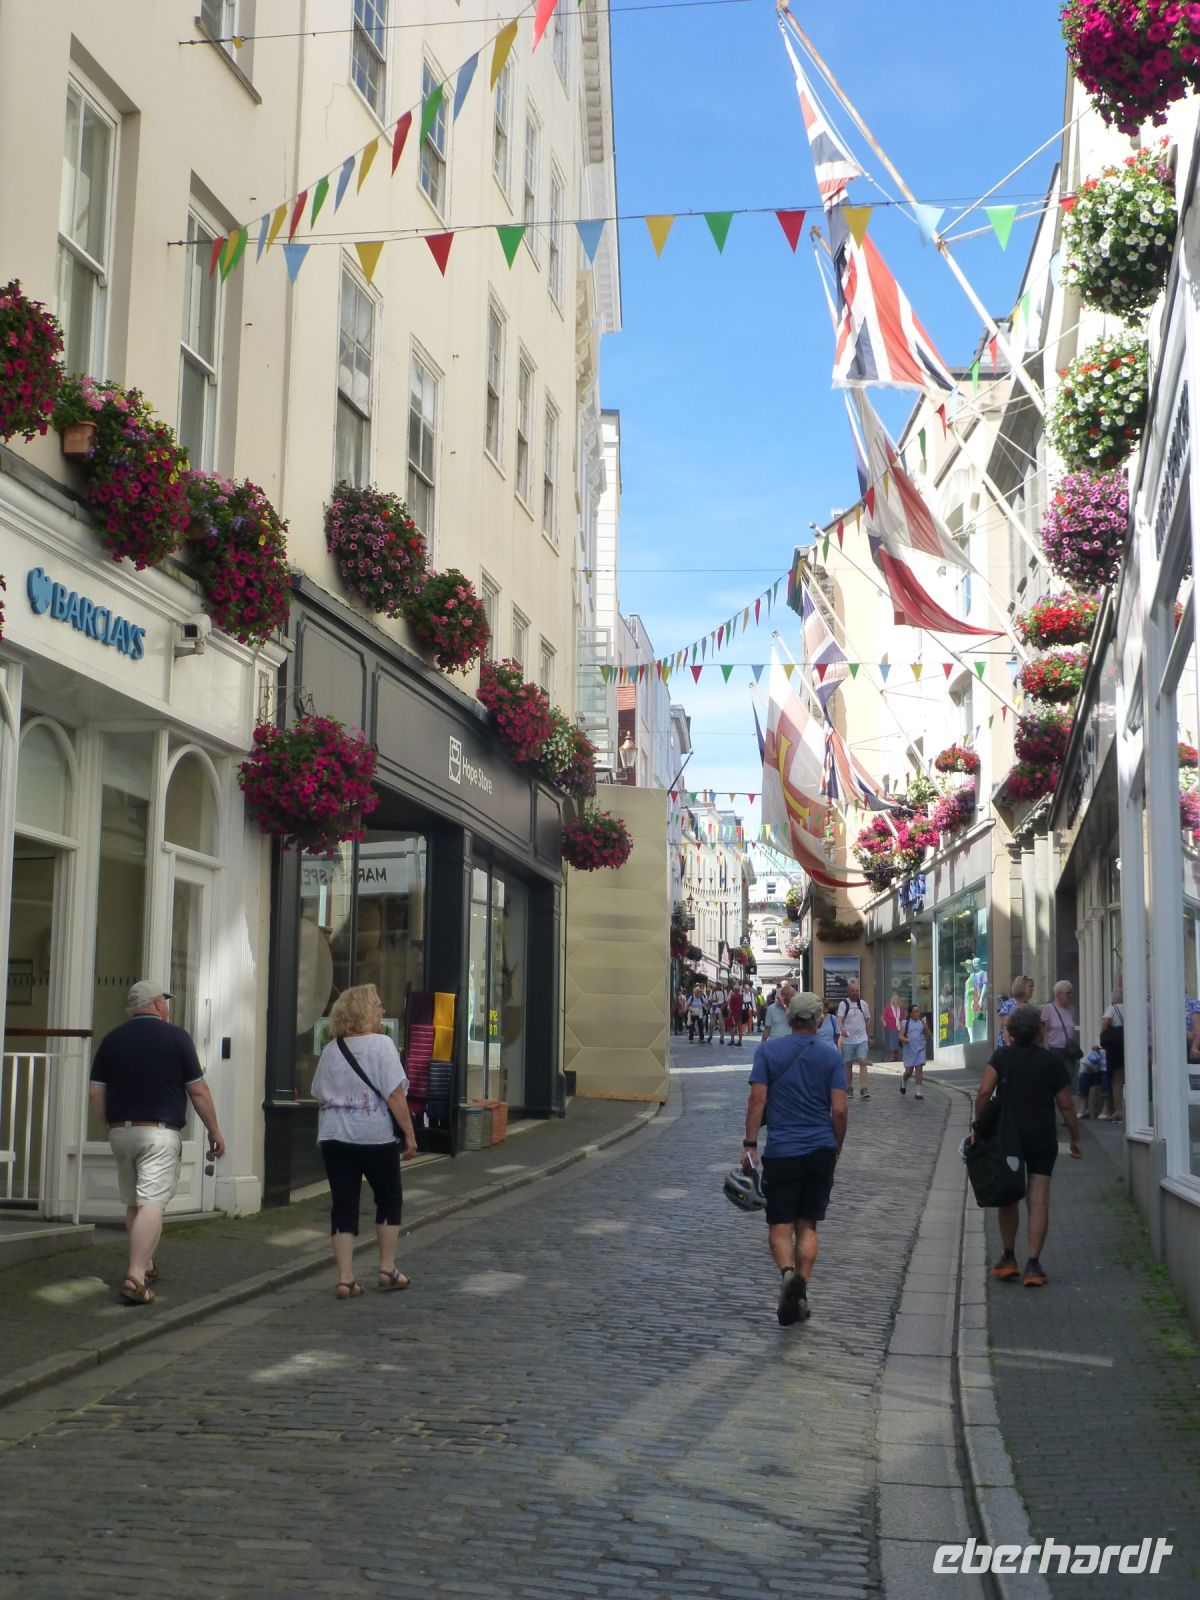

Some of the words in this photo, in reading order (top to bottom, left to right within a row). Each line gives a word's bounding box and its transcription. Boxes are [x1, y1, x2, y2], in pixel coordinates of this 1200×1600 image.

[51, 582, 146, 661] BARCLAYS
[462, 755, 478, 786] Hope
[478, 767, 493, 796] Store
